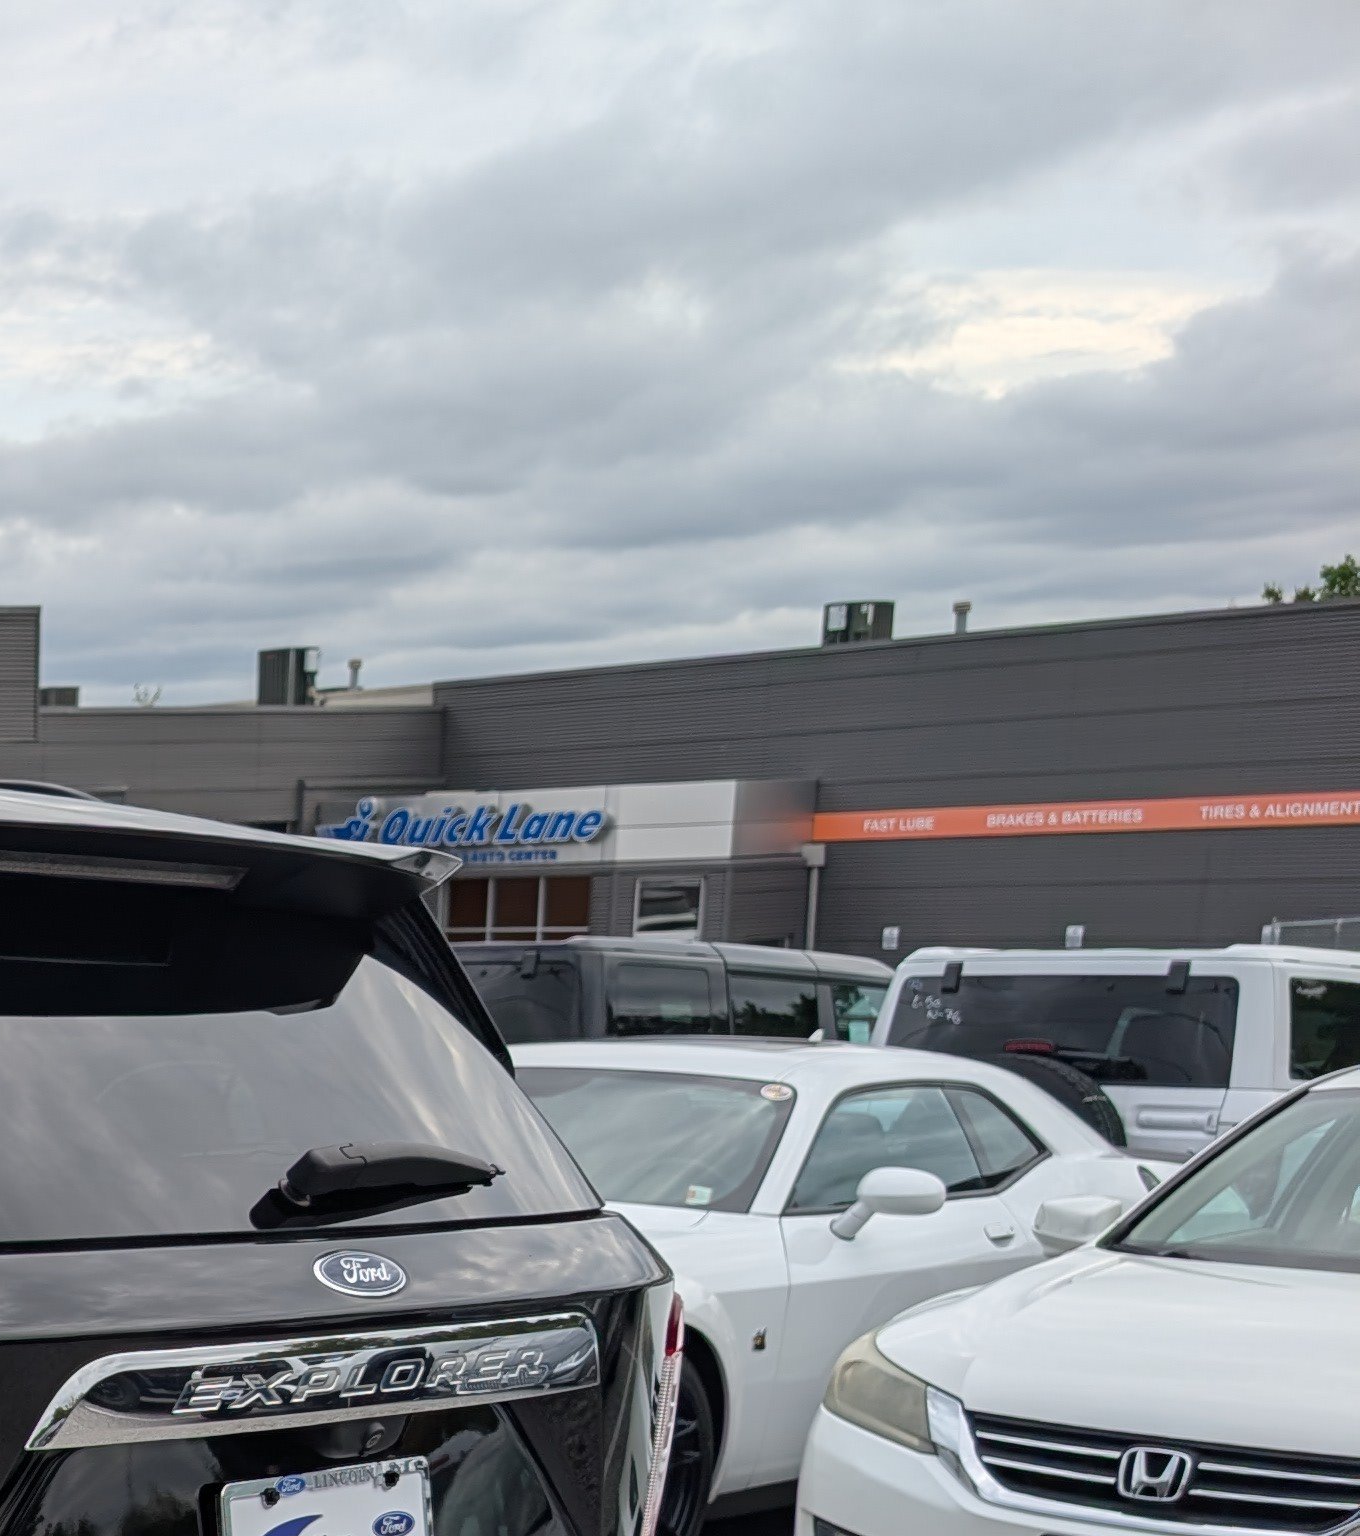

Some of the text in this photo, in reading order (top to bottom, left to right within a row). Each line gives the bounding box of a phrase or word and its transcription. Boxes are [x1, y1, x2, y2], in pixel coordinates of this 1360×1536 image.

[378, 803, 606, 847] Quick Lane
[863, 818, 896, 832] FAST
[899, 816, 935, 831] LUBE
[986, 811, 1044, 828] BRAKES
[1047, 812, 1057, 825] &
[1062, 808, 1143, 825] BATTERIES
[1200, 804, 1245, 820] TIRES
[1249, 803, 1260, 818] &
[340, 1256, 391, 1284] Ford
[172, 1345, 548, 1415] EXPLORER
